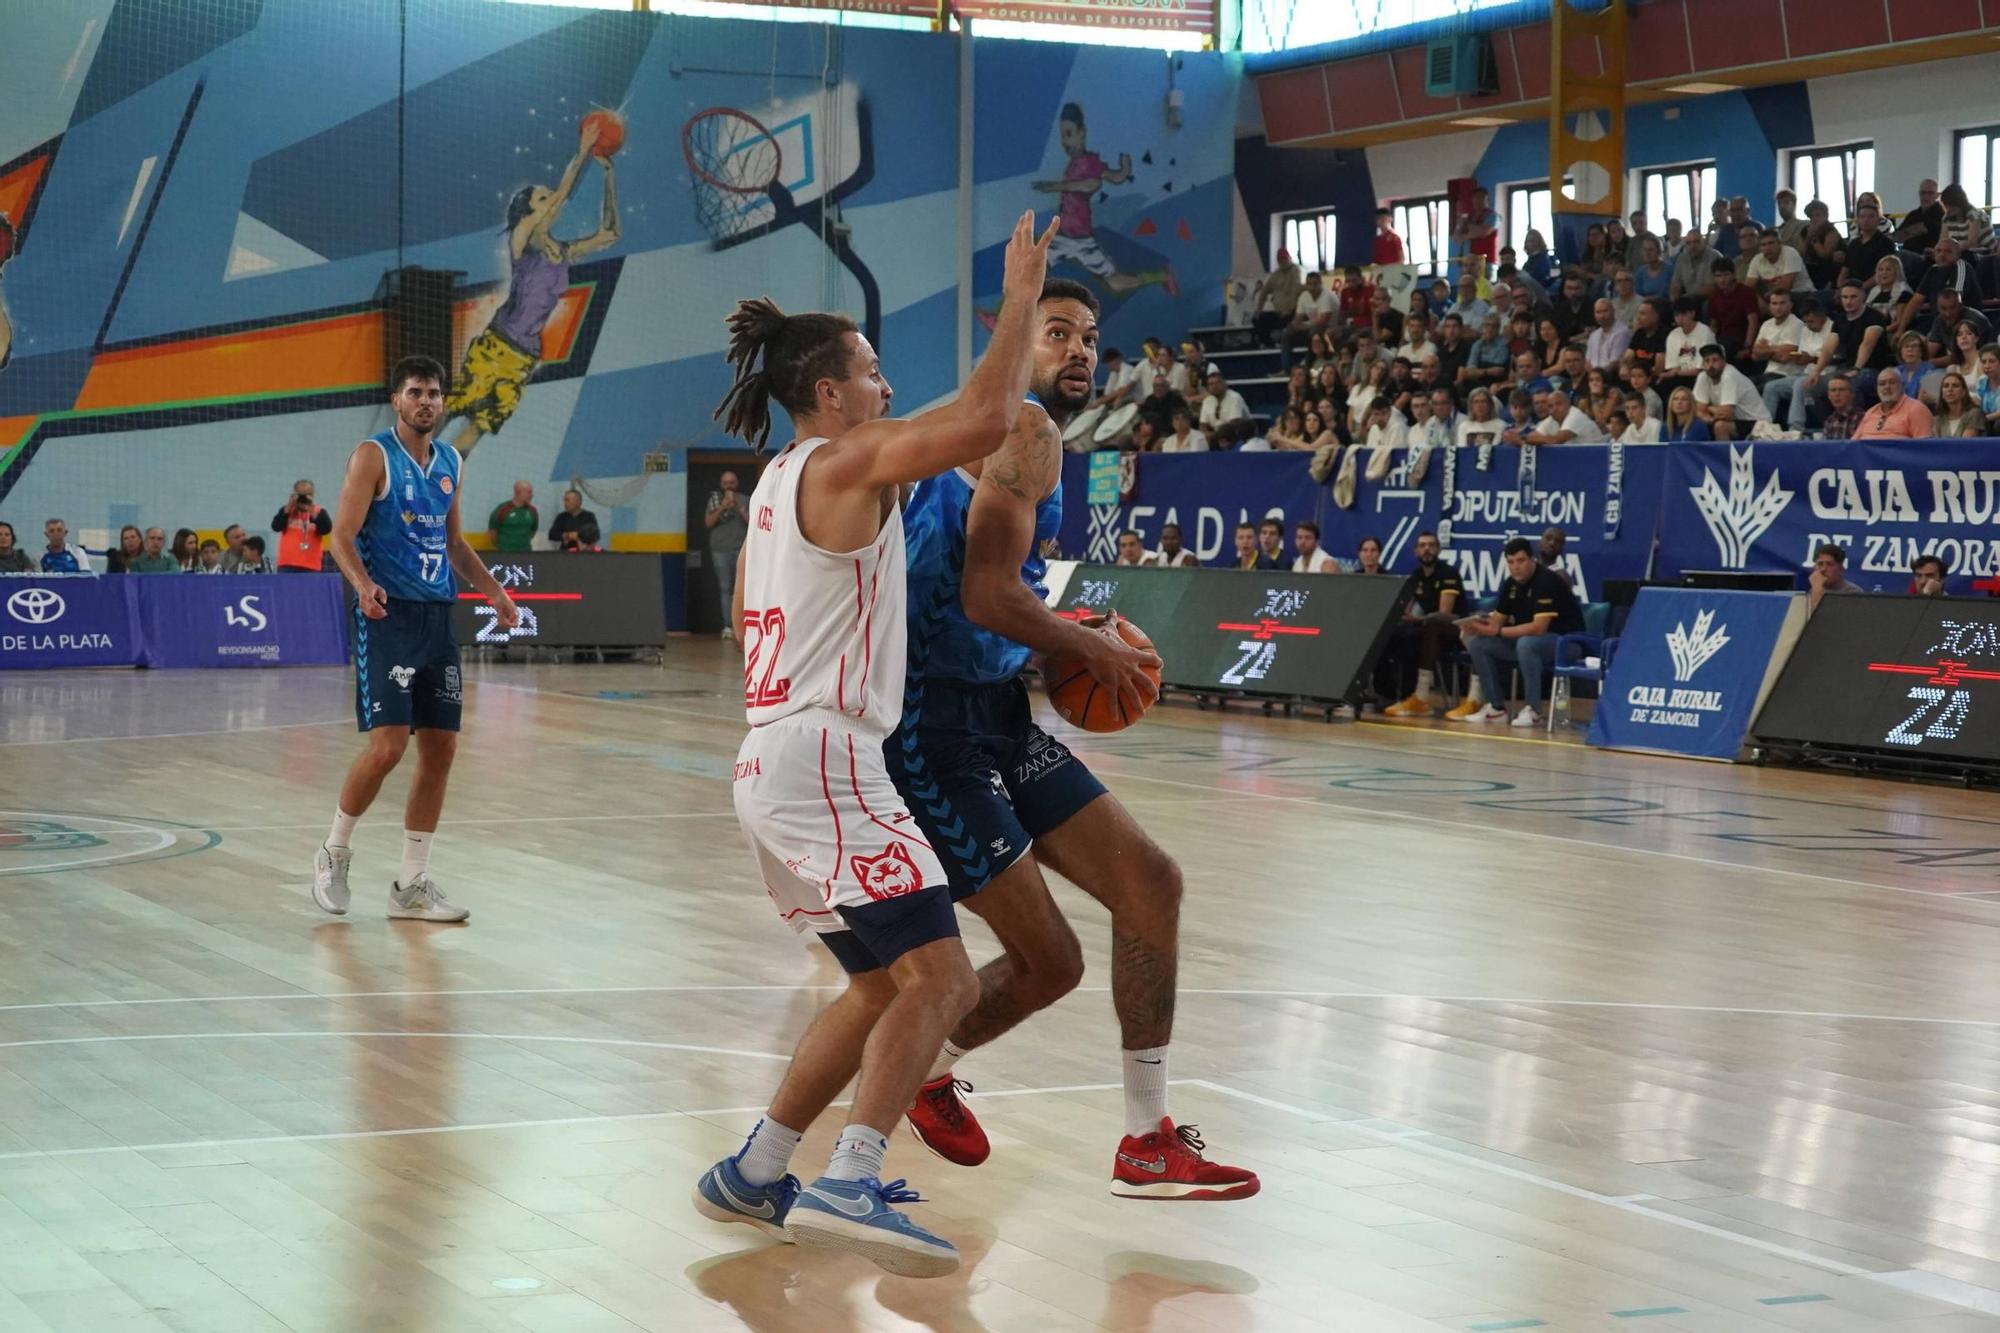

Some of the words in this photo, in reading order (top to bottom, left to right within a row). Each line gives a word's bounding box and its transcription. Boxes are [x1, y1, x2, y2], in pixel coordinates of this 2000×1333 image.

[1086, 14, 1102, 24] DE
[1111, 15, 1180, 28] DEPORTES
[1808, 468, 1919, 525] CAJA
[1927, 470, 2000, 525] RU
[418, 552, 443, 582] 17
[3, 636, 27, 651] DE
[32, 634, 54, 650] LA
[59, 633, 113, 649] PLATA
[744, 607, 791, 708] 22
[1628, 685, 1666, 707] CAJA
[1667, 689, 1722, 711] RURAL
[1630, 708, 1649, 722] DE
[1649, 710, 1700, 728] ZAMORA
